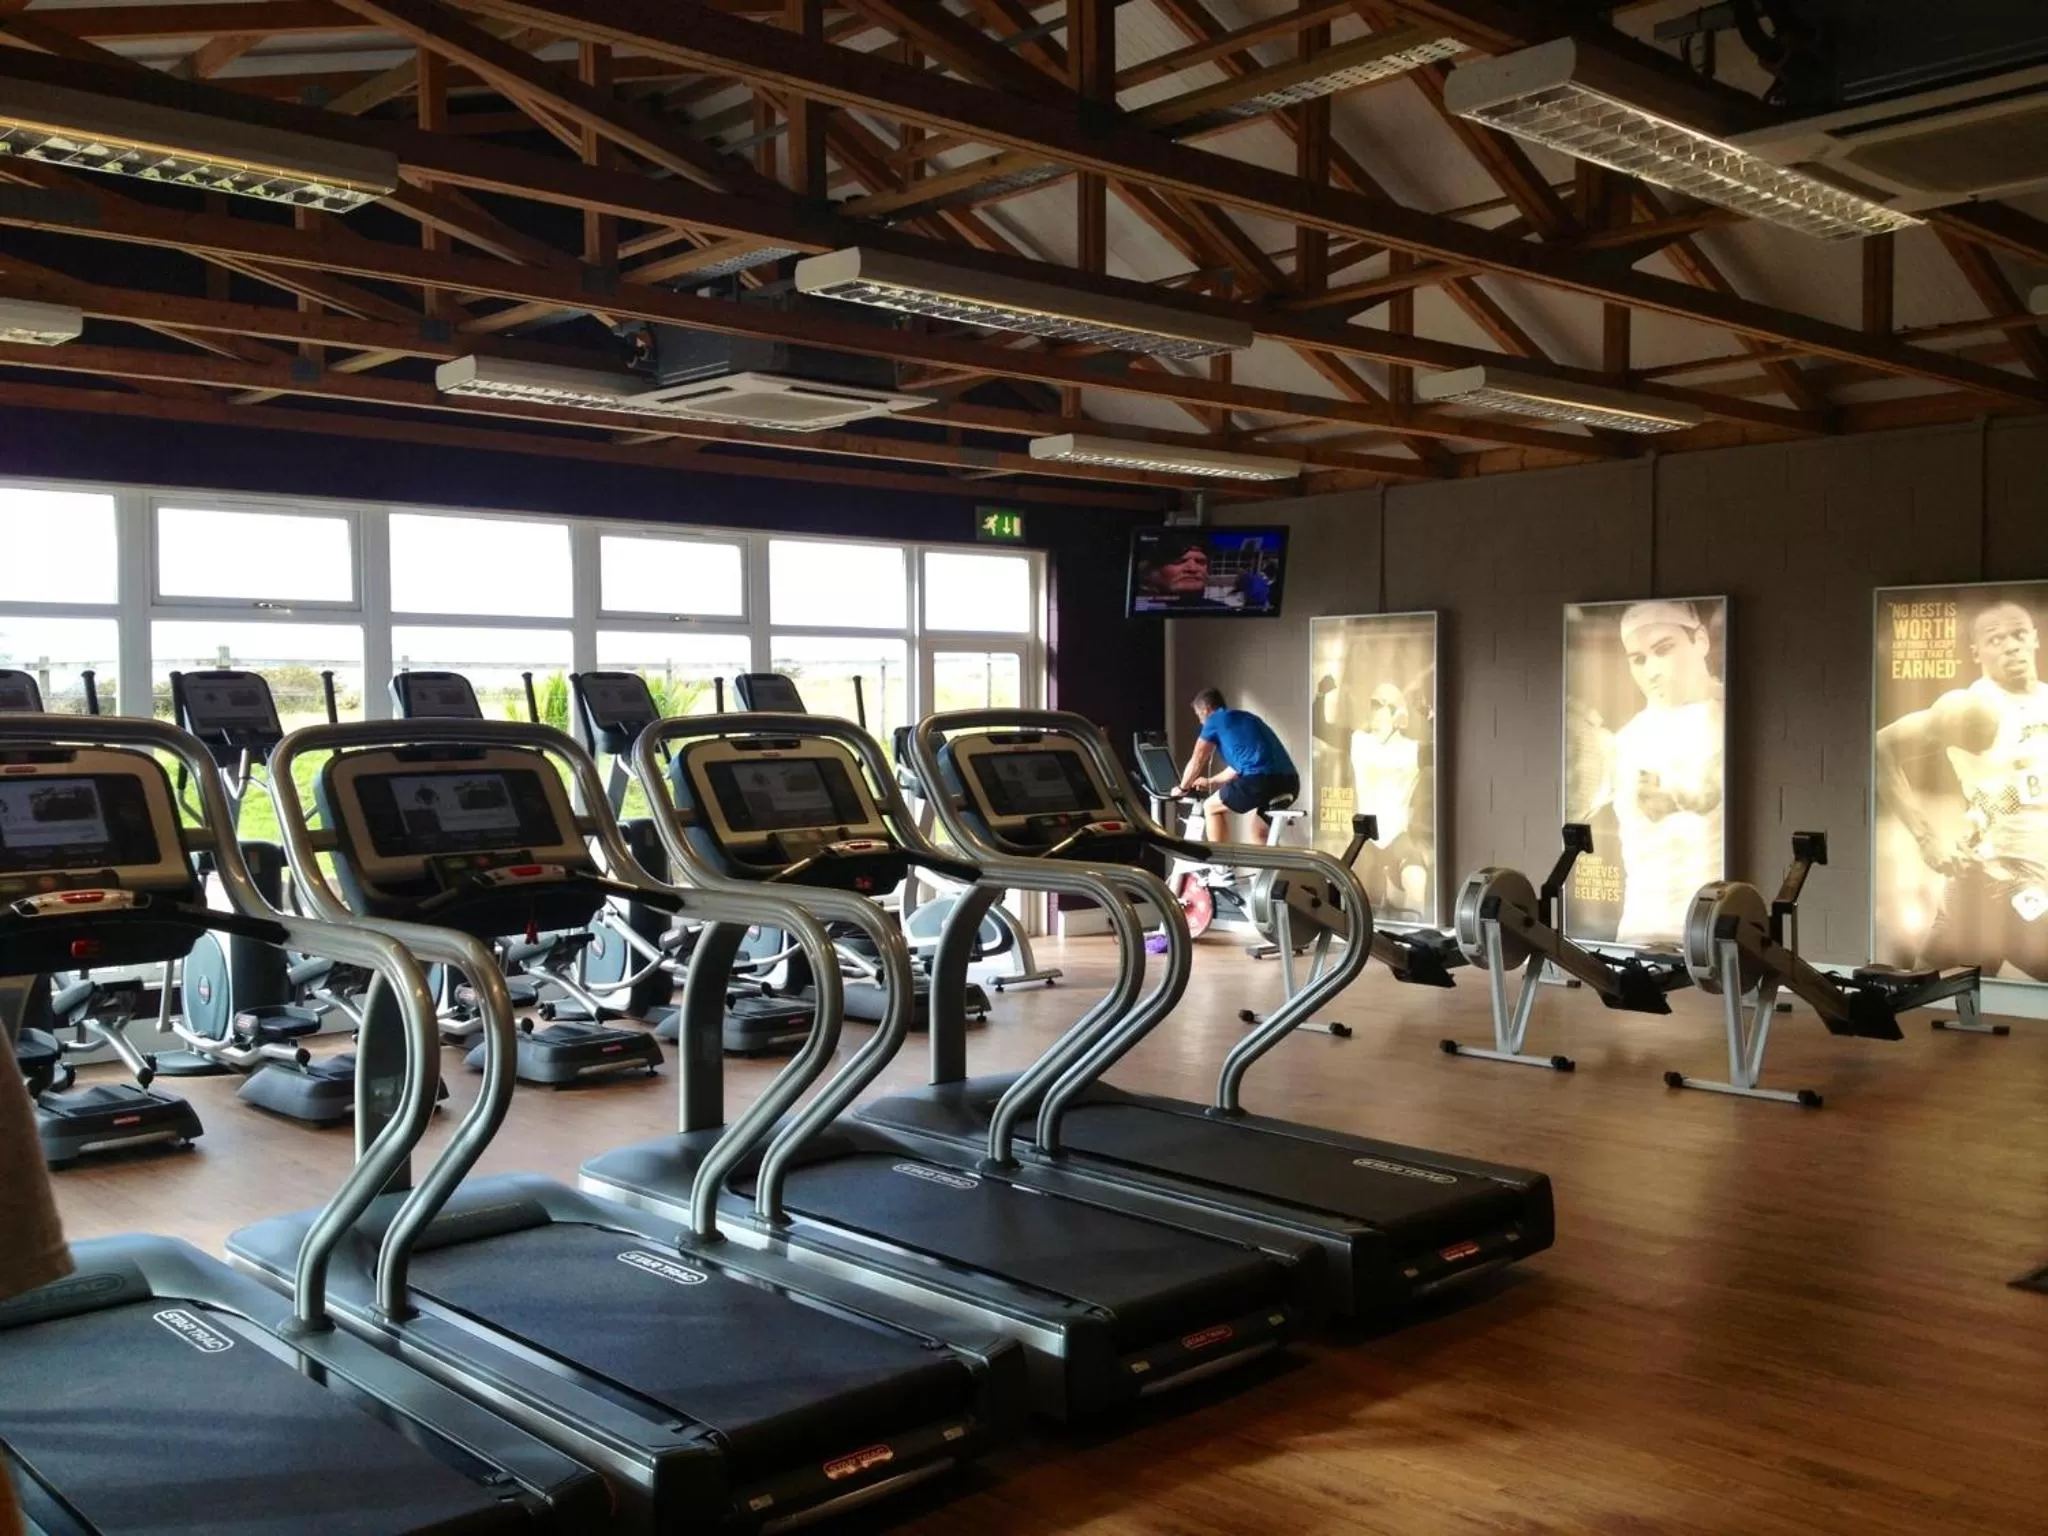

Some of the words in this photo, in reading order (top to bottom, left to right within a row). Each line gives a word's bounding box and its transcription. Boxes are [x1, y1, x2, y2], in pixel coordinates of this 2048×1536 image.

[1911, 603, 1942, 617] REST
[1944, 602, 1956, 617] IS
[1893, 618, 1956, 640] WORTH
[1575, 864, 1620, 880] ACHIEVES
[623, 1252, 662, 1269] STAR
[659, 1265, 699, 1282] TRAC
[160, 1311, 197, 1331] STAR
[187, 1327, 224, 1349] TRAC
